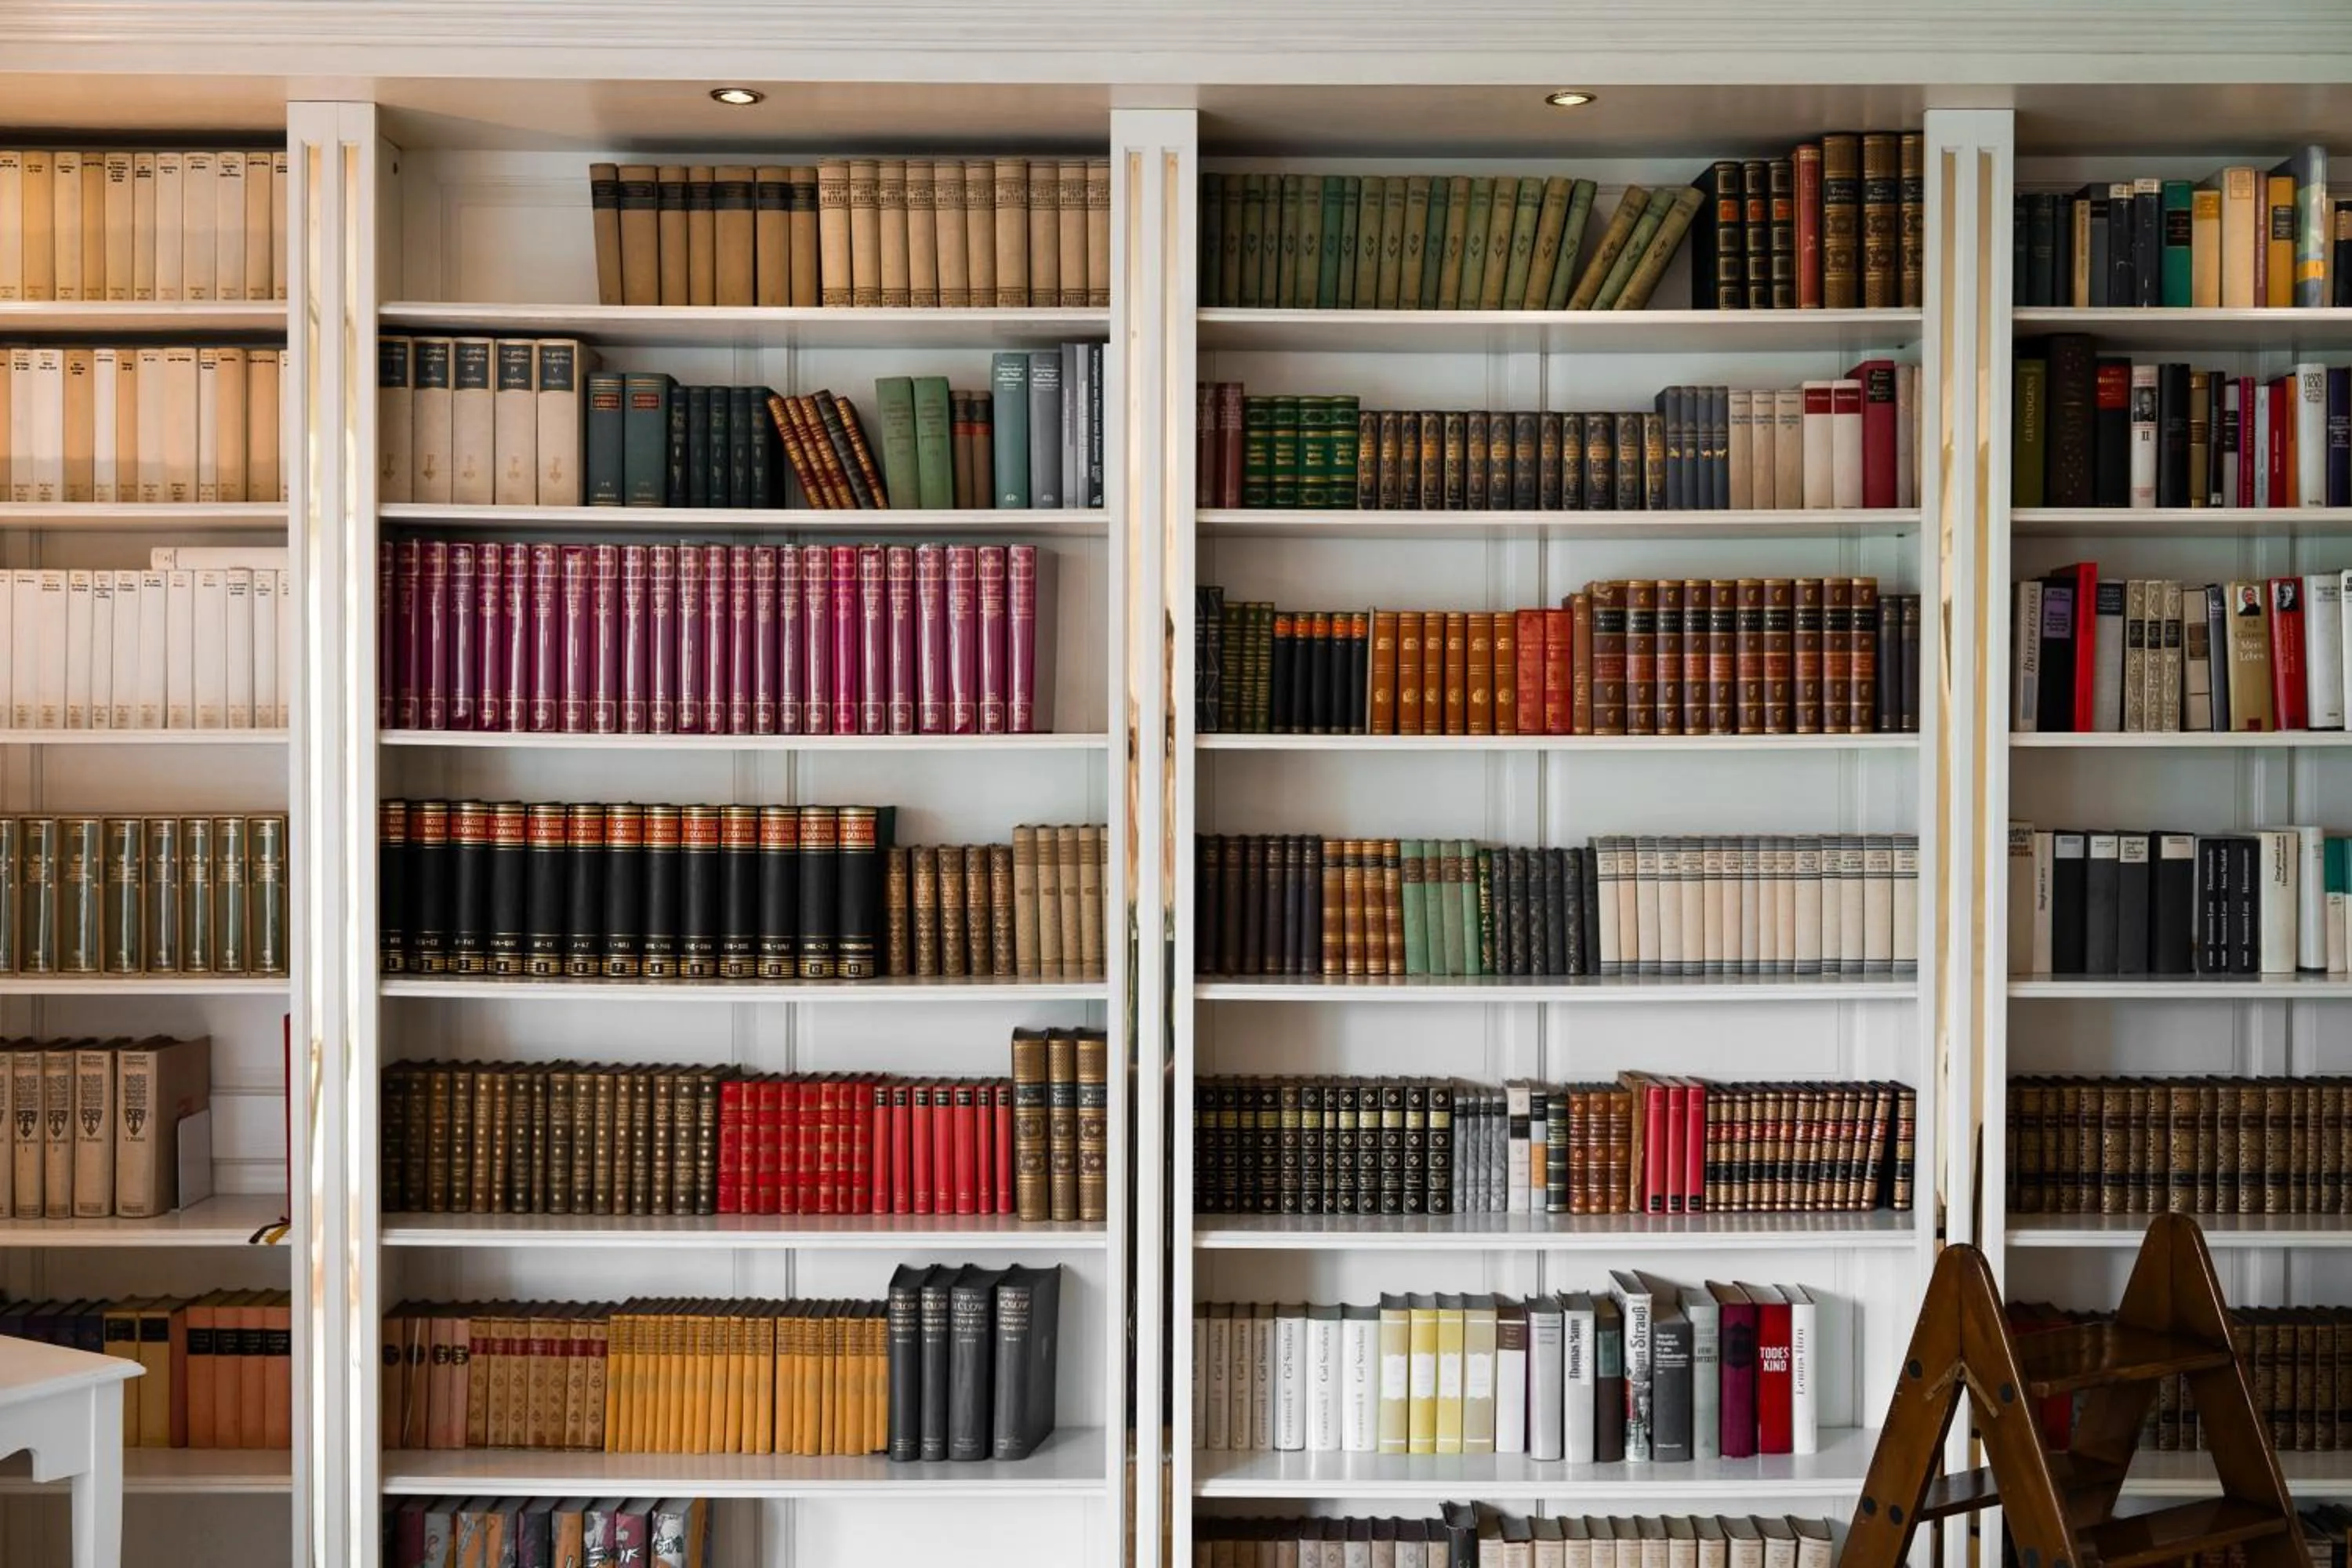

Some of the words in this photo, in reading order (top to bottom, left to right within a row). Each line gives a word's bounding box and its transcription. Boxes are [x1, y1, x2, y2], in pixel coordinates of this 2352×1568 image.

[1630, 1306, 1648, 1348] Strauß
[1570, 1344, 1580, 1379] Thomas
[1759, 1346, 1790, 1359] TODES
[1763, 1360, 1788, 1372] KIND
